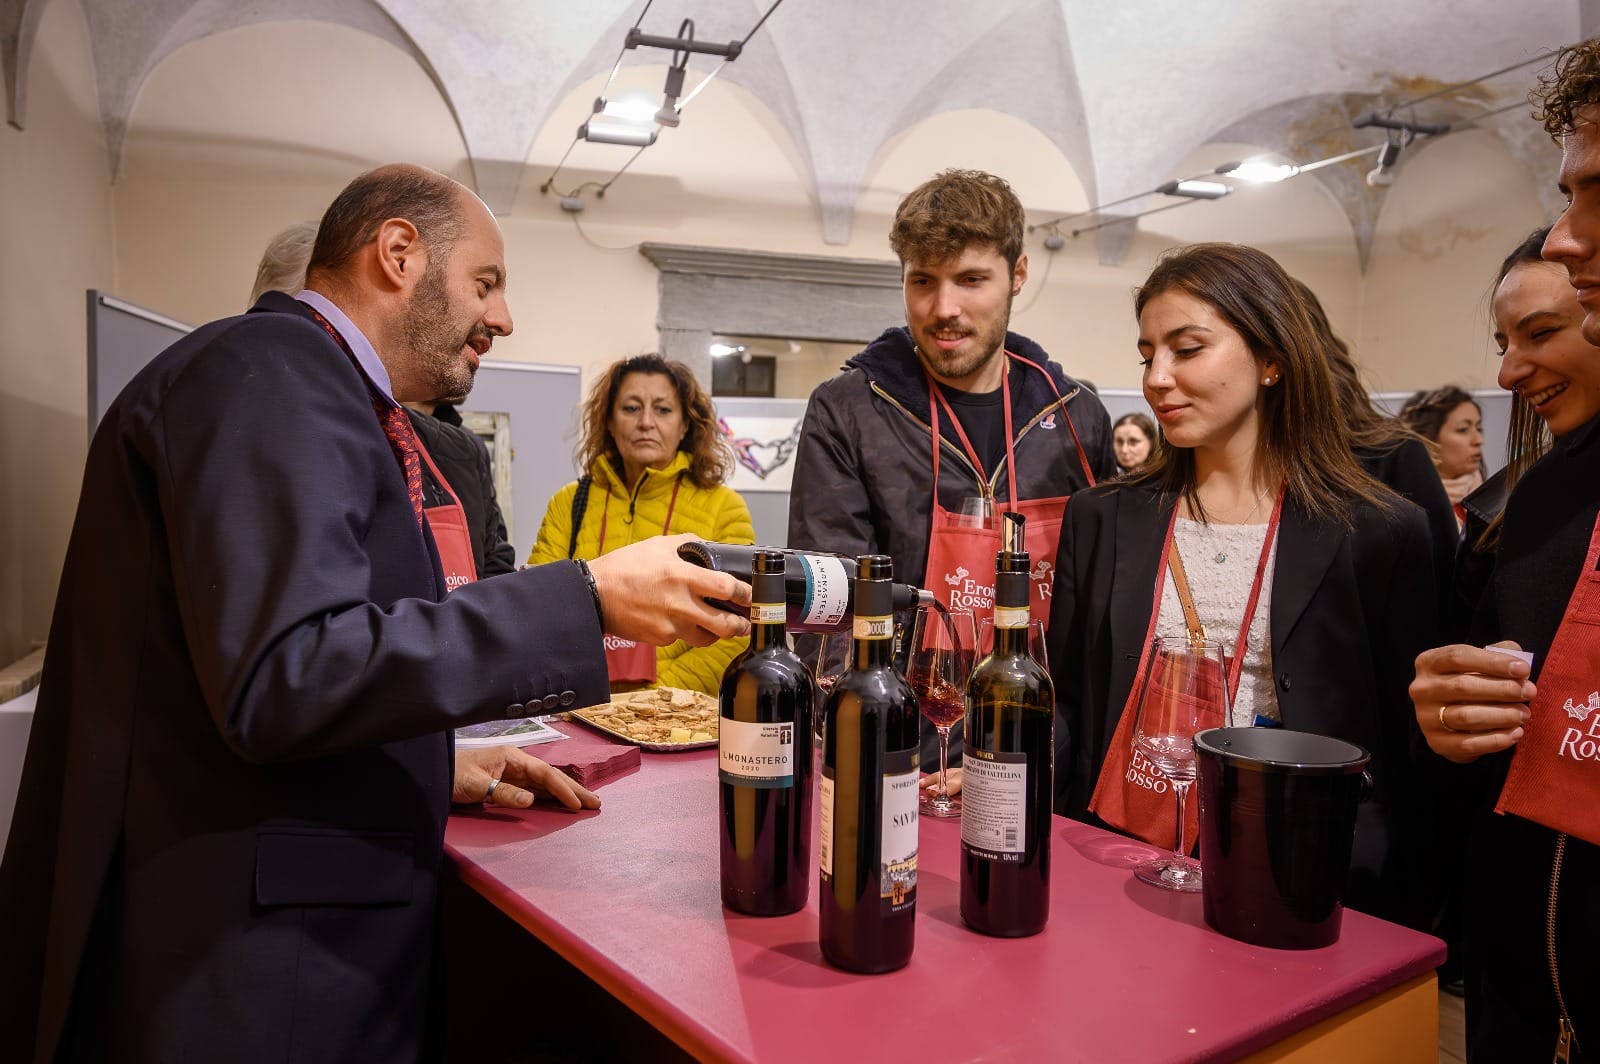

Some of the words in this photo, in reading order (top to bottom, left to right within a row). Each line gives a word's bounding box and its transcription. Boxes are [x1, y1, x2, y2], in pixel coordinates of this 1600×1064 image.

[949, 589, 993, 612] Rosso
[728, 752, 788, 765] MONASTERO
[987, 770, 1022, 779] VALTELLINA
[892, 812, 910, 829] SAN
